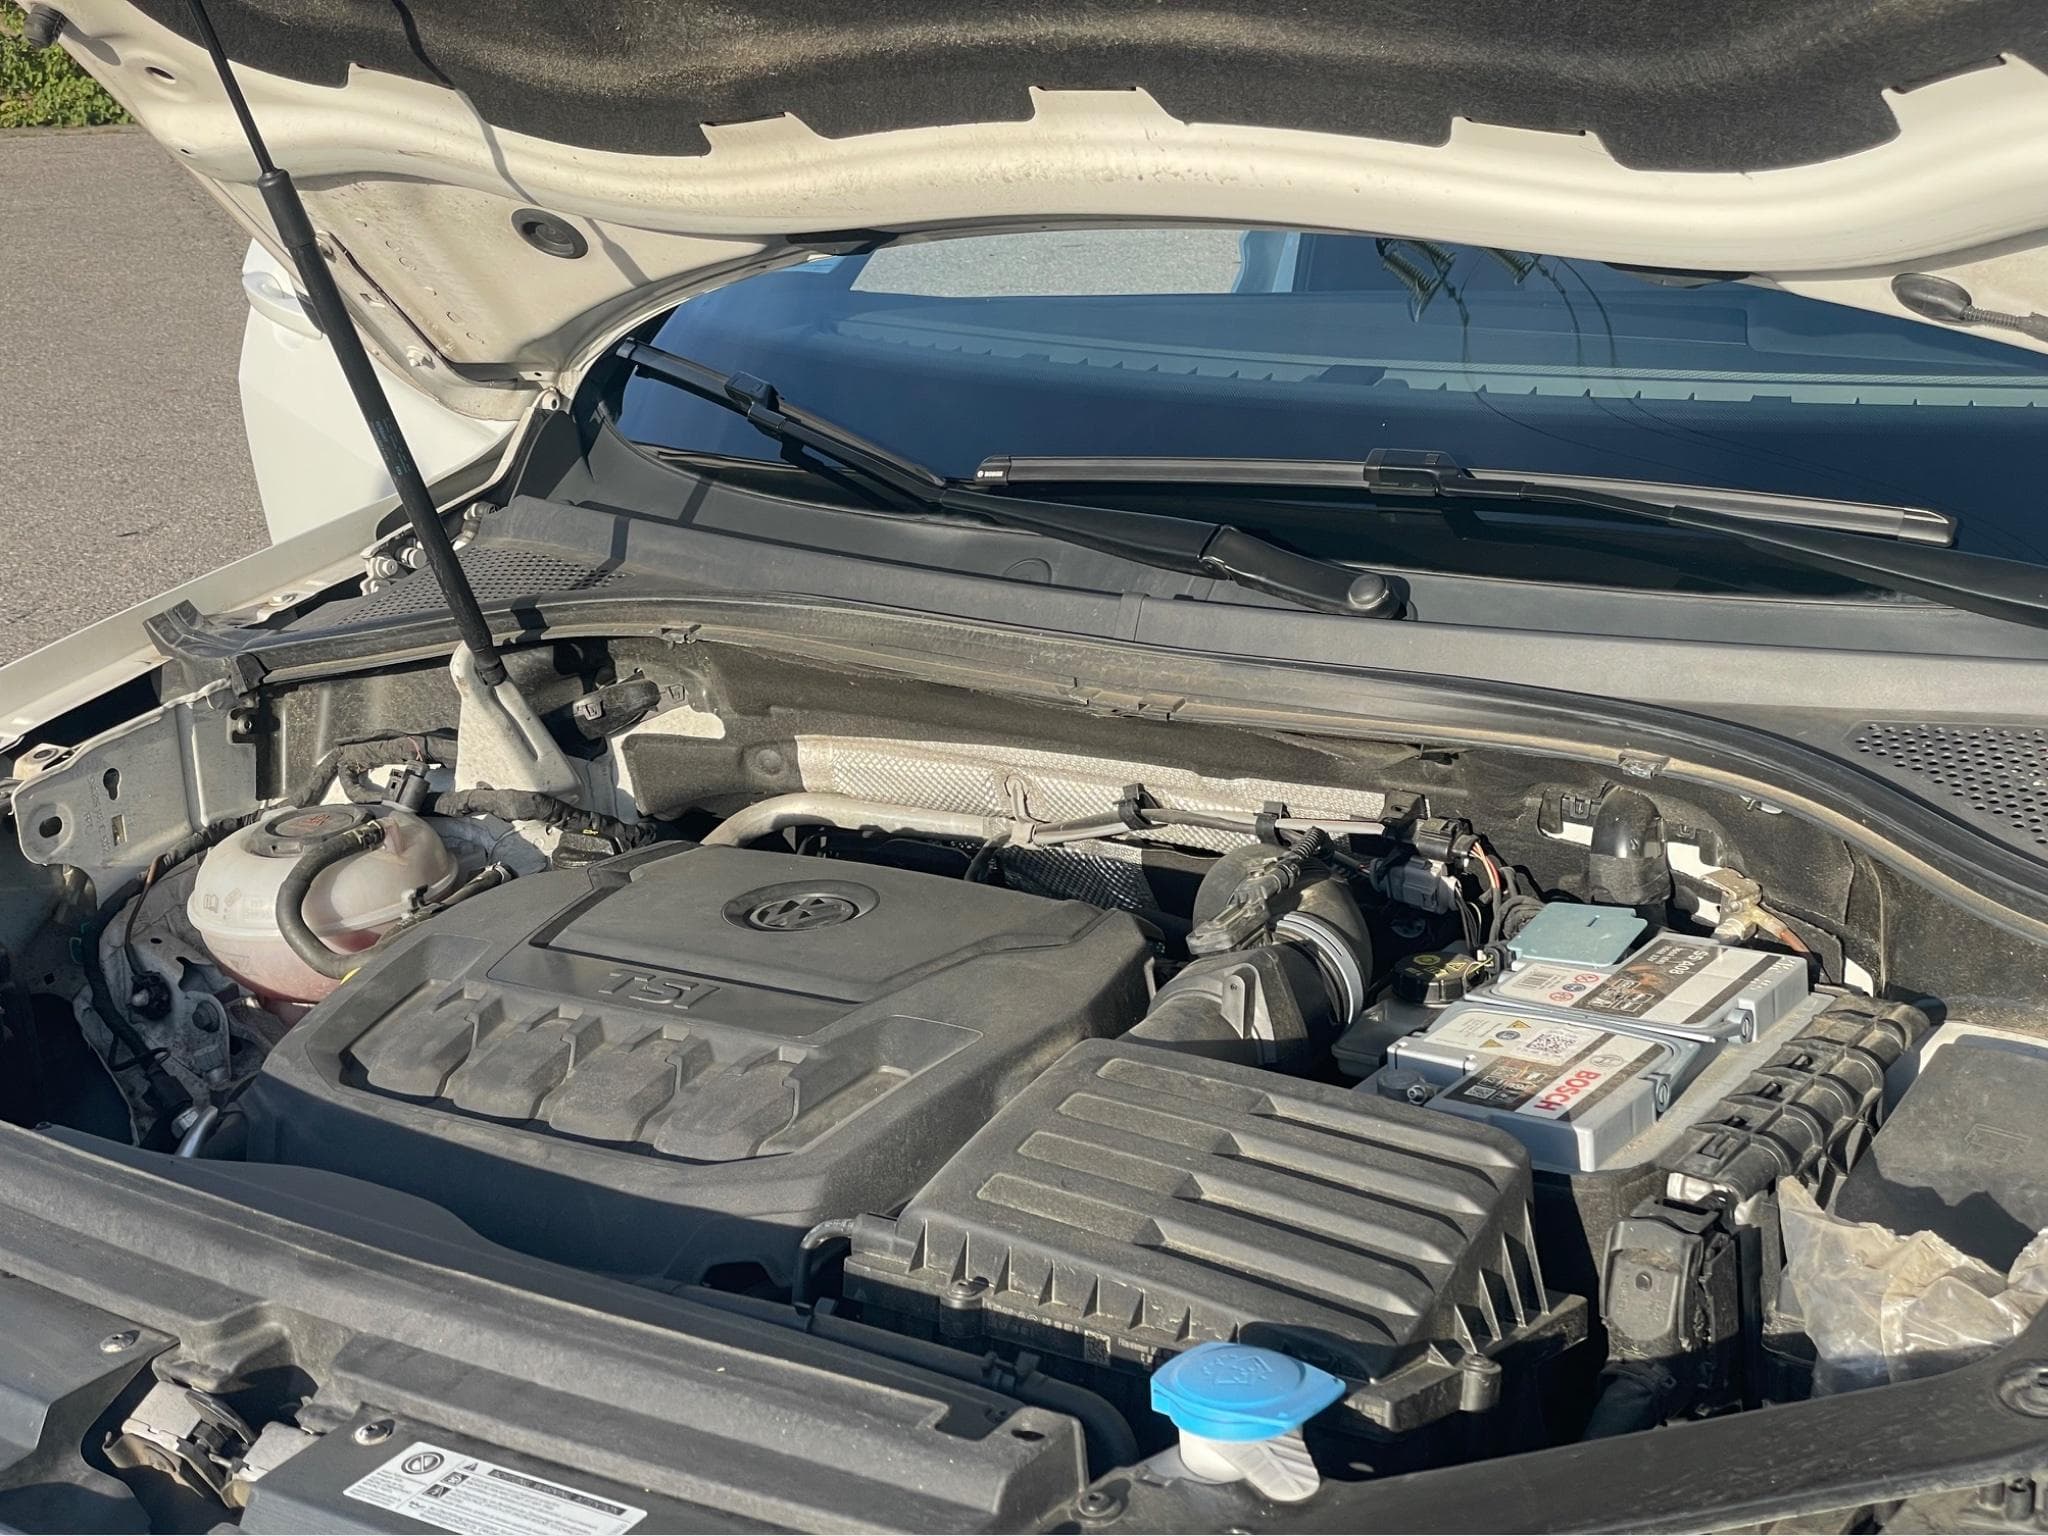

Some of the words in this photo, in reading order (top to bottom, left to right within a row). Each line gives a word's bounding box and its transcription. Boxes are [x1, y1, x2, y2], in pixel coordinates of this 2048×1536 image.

[1668, 960, 1696, 975] A08
[598, 969, 720, 1010] TSI
[1533, 1070, 1602, 1111] BOSCH
